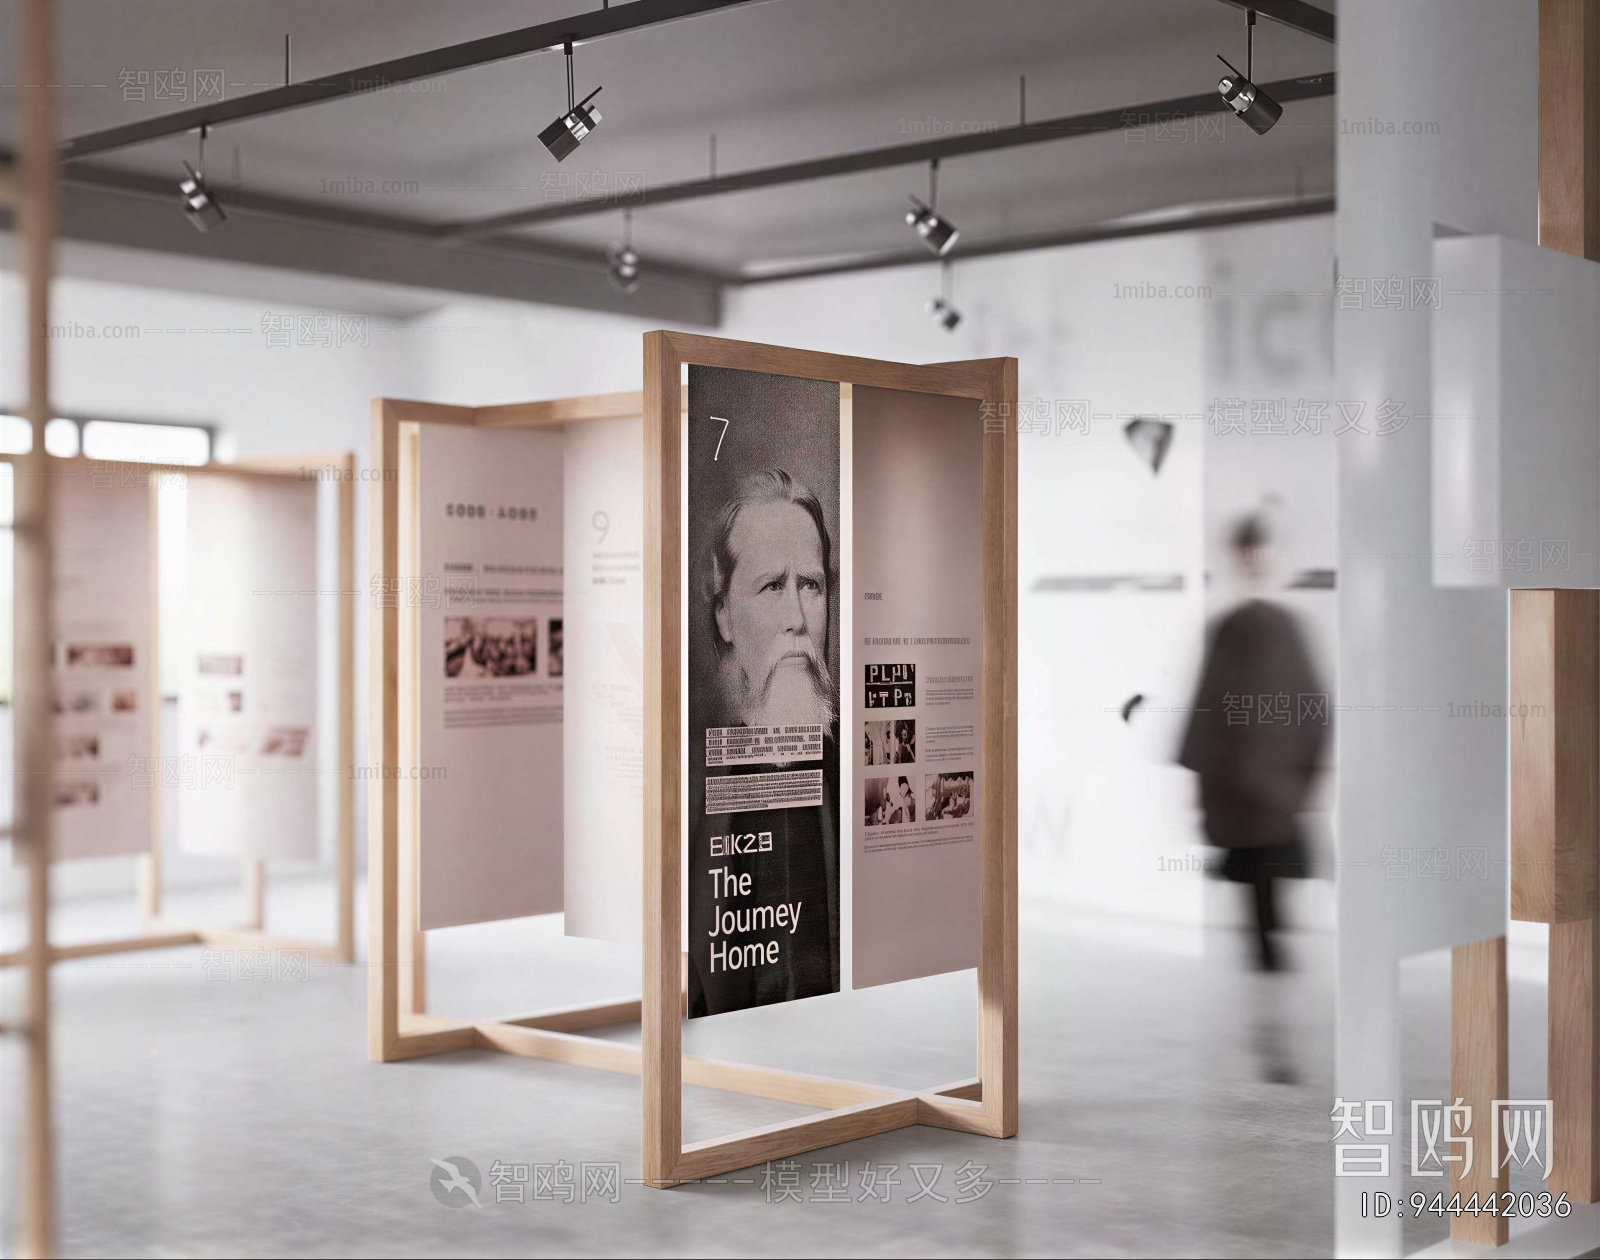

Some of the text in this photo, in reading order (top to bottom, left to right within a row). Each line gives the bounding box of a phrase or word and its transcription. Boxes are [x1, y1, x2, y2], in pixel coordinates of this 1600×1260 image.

[710, 415, 729, 461] 7
[591, 510, 609, 546] 9
[709, 866, 752, 899] The
[710, 939, 780, 973] Home
